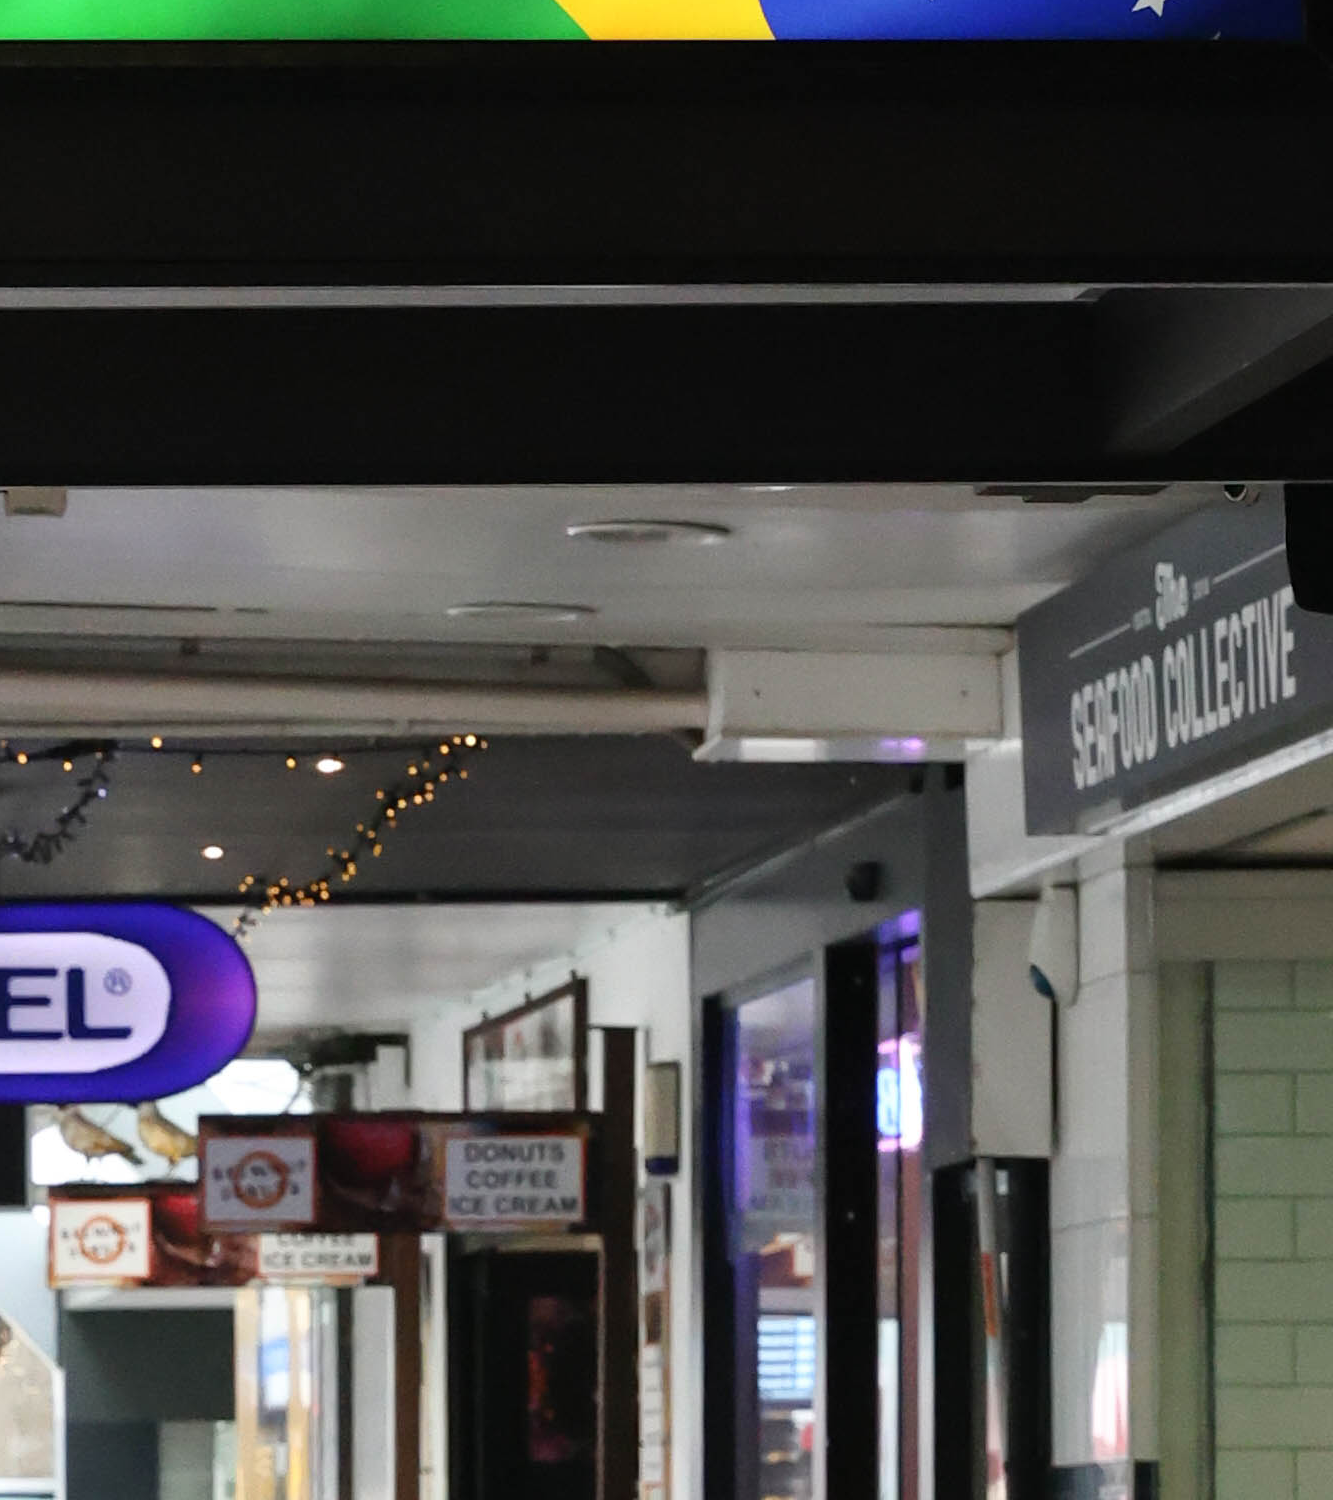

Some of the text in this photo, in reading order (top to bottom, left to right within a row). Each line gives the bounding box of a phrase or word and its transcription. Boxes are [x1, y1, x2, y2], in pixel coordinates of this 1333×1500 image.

[1071, 585, 1296, 790] SEAFOOD COLLECTIVE
[464, 1142, 565, 1165] DONUTS
[465, 1169, 558, 1189] COFFEE
[450, 1195, 578, 1215] ICE CREAM
